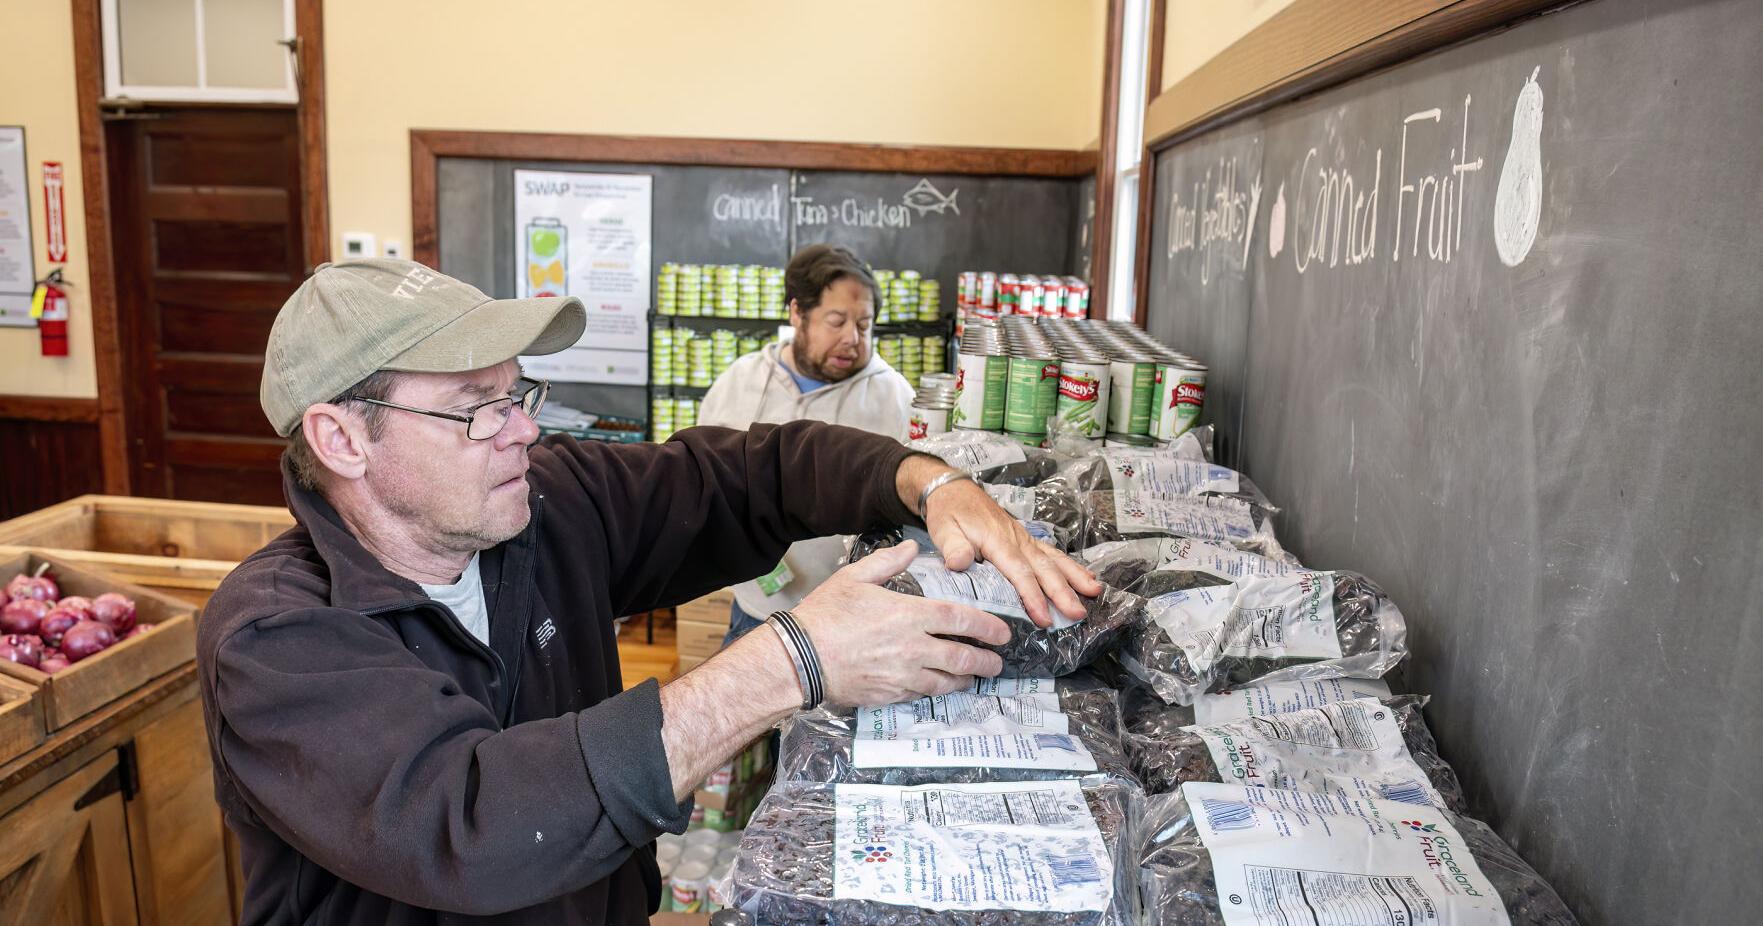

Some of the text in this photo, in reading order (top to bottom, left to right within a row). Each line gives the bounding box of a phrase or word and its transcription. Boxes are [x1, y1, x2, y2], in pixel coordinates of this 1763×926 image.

[525, 180, 570, 197] SWAP
[1294, 93, 1484, 274] Canned Fruit
[841, 197, 911, 228] Chicken
[1418, 835, 1442, 871] Fruit
[1433, 835, 1484, 897] Graceland
[1421, 898, 1434, 919] Facts
